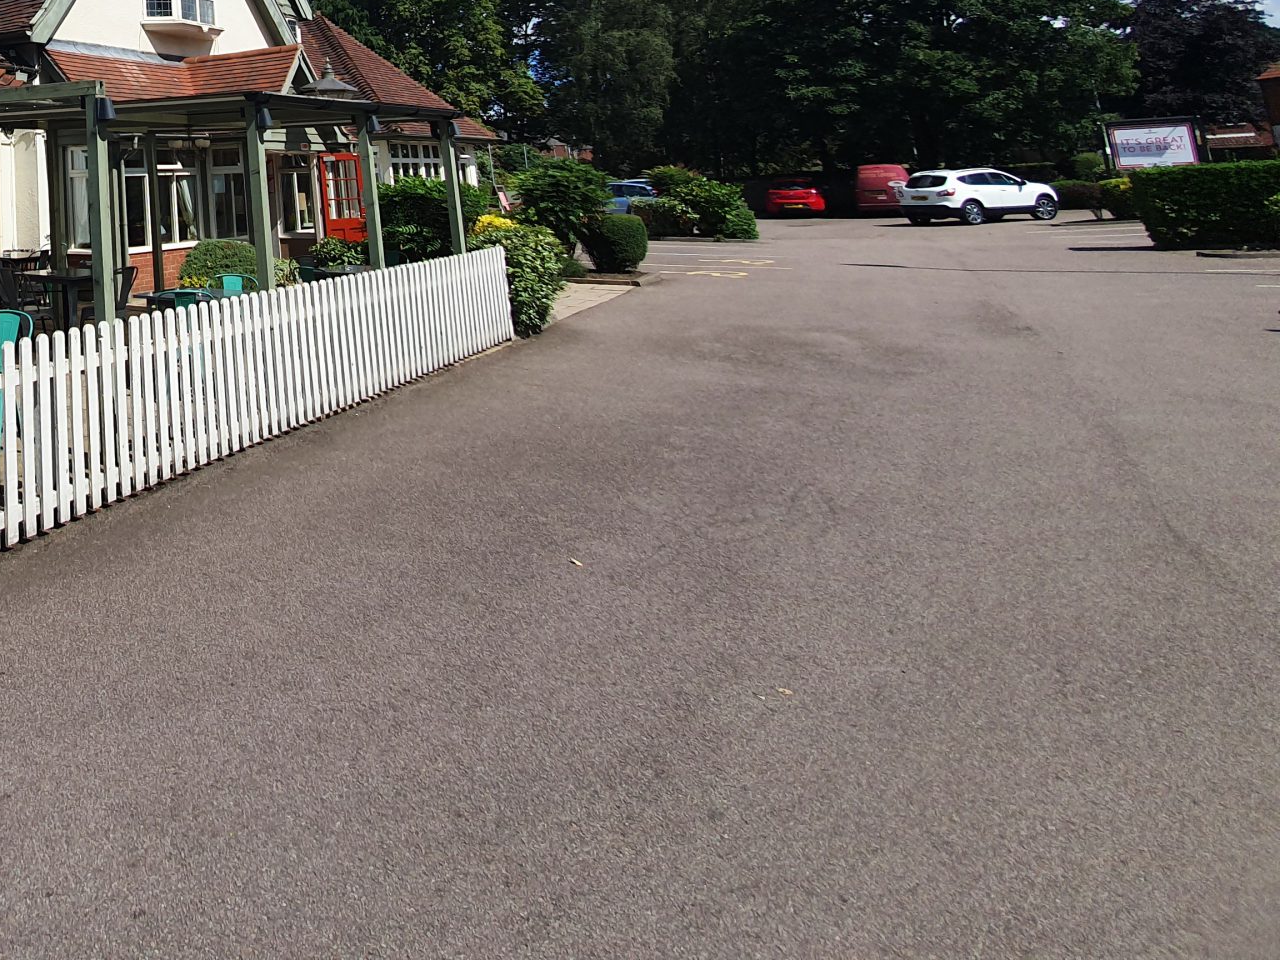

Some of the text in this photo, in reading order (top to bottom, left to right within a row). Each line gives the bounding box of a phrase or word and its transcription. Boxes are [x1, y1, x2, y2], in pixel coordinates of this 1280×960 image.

[1120, 135, 1184, 146] IT'S GREAT
[1155, 143, 1187, 151] BACK!
